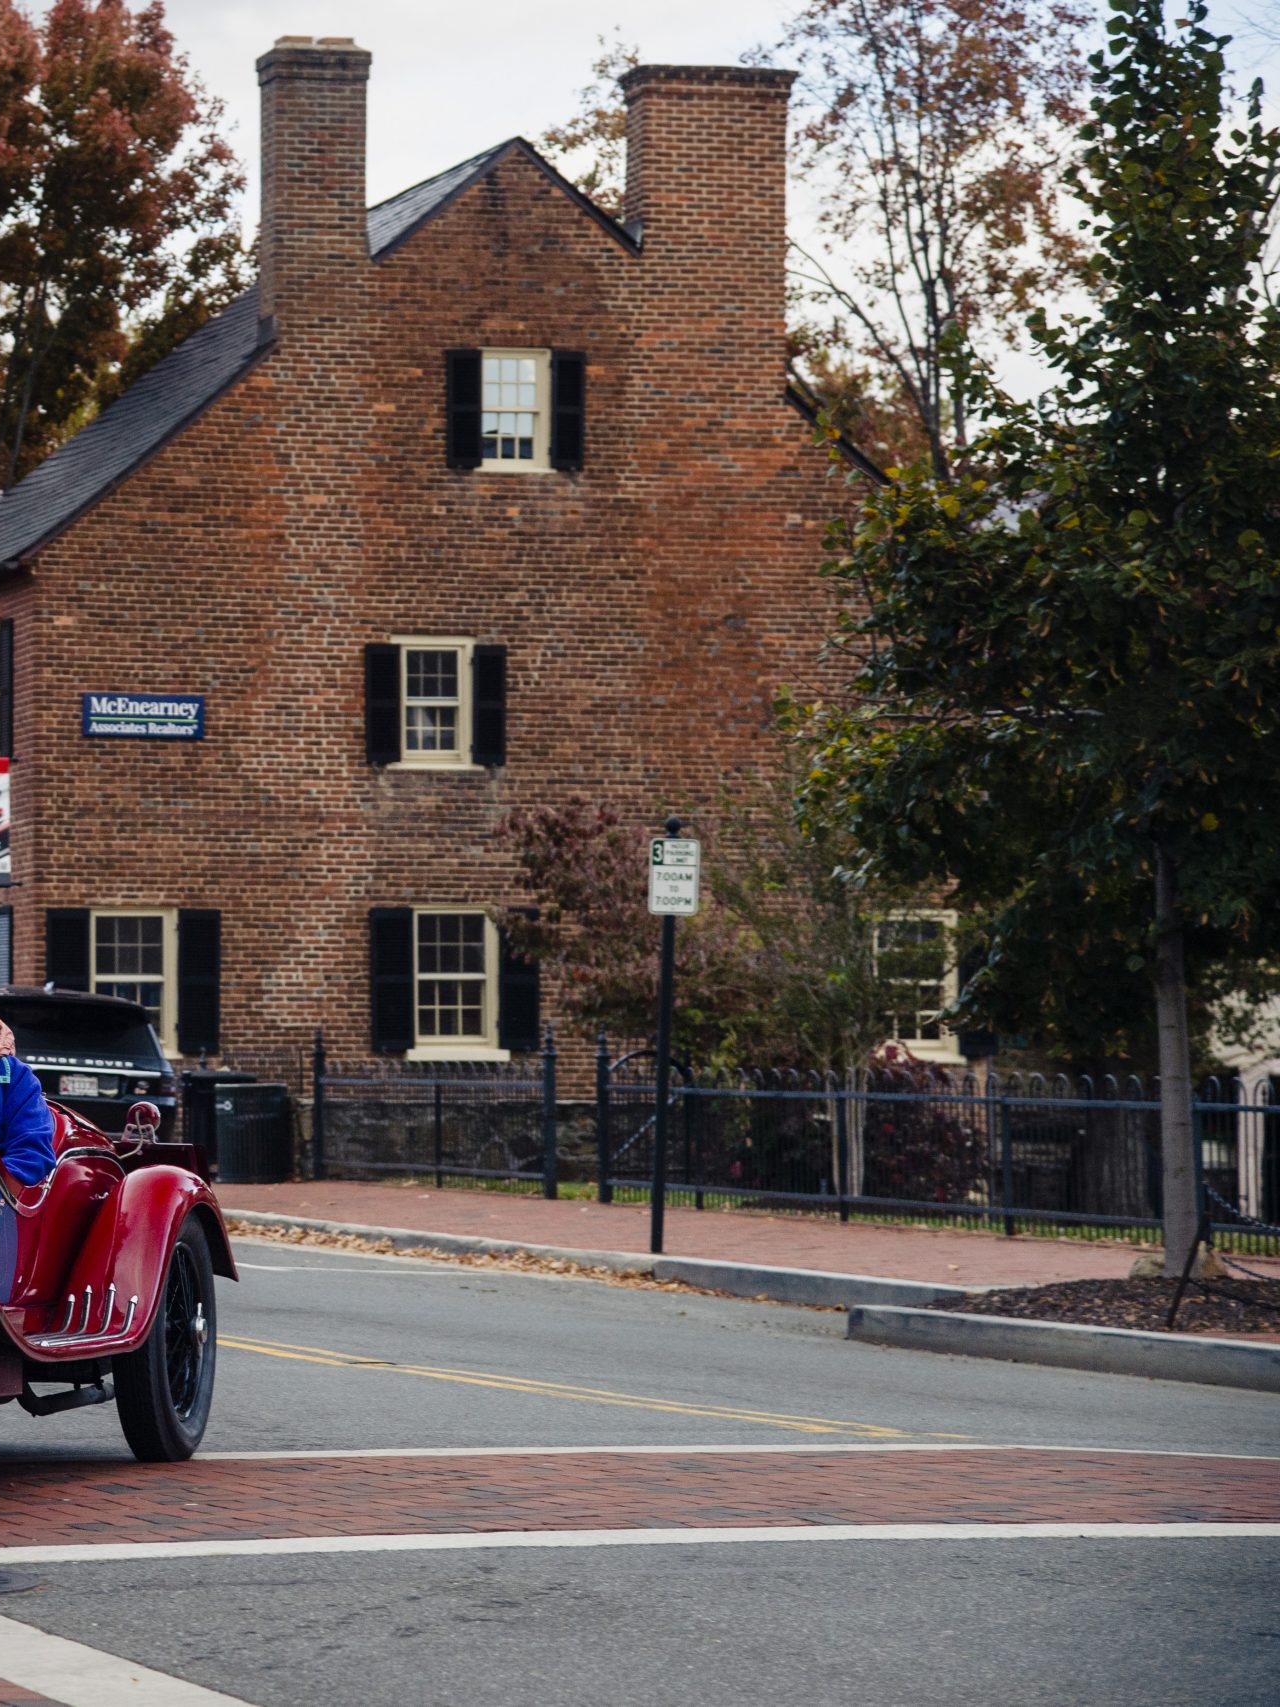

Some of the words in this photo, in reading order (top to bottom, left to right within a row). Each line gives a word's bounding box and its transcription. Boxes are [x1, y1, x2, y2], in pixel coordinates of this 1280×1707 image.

[90, 696, 199, 720] McEnearney
[89, 721, 146, 733] Associates
[653, 844, 663, 862] 3
[26, 1055, 77, 1064] RANGE
[84, 1058, 134, 1068] ROVER
